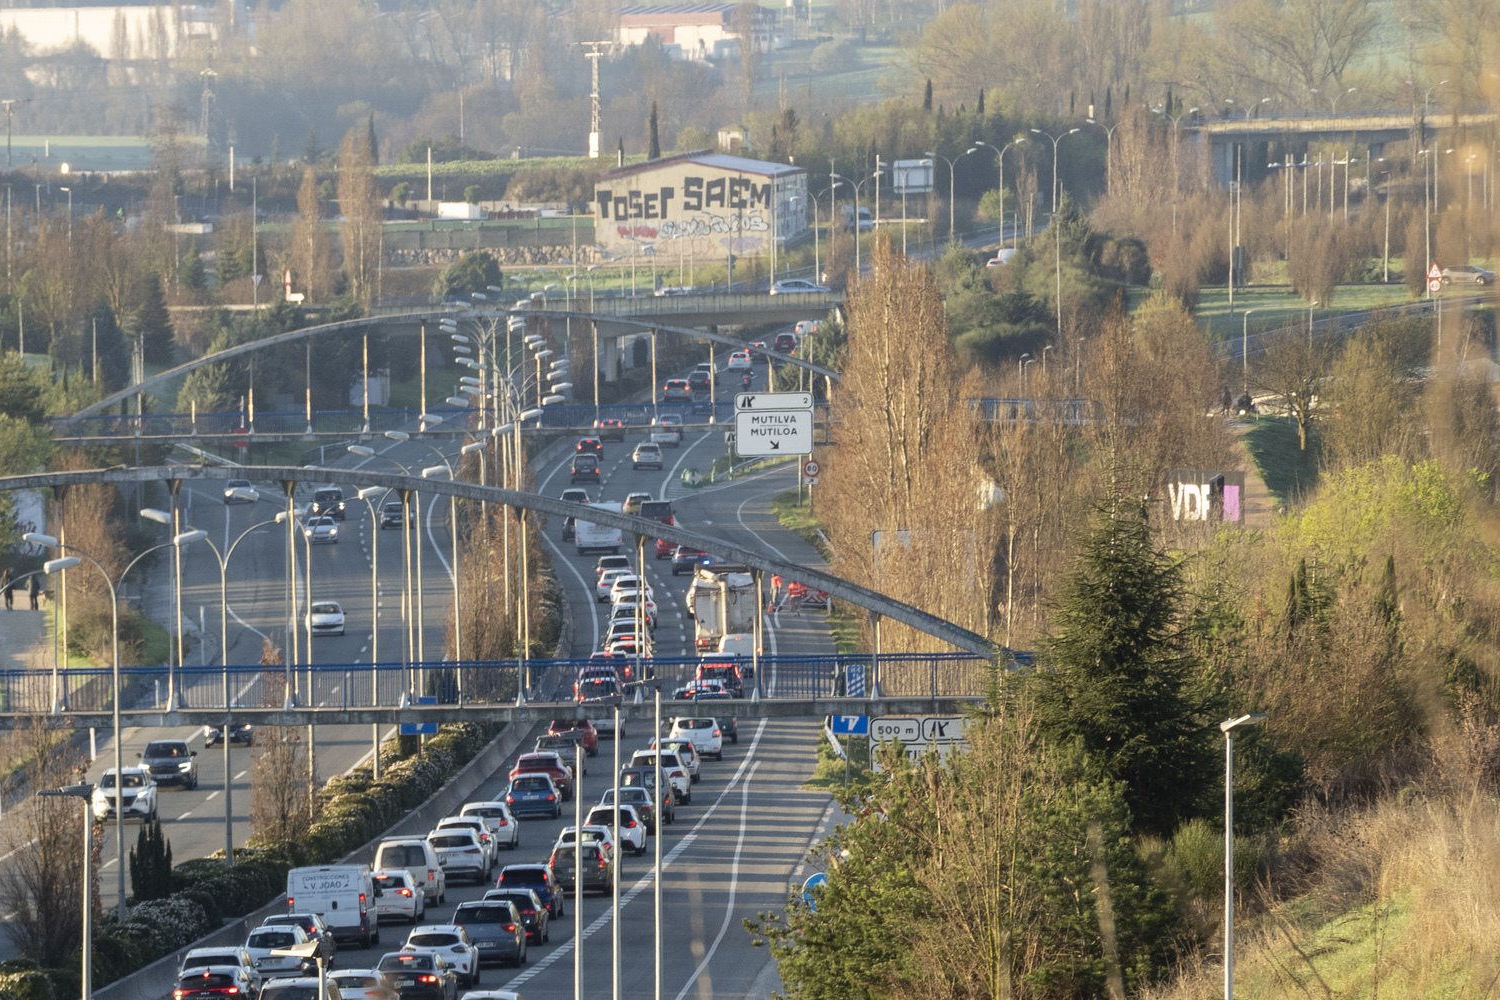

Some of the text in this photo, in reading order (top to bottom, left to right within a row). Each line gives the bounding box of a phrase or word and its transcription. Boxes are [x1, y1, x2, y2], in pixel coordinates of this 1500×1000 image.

[751, 415, 797, 424] MUTILVA
[750, 428, 798, 436] MUTILOA
[877, 725, 901, 735] 500
